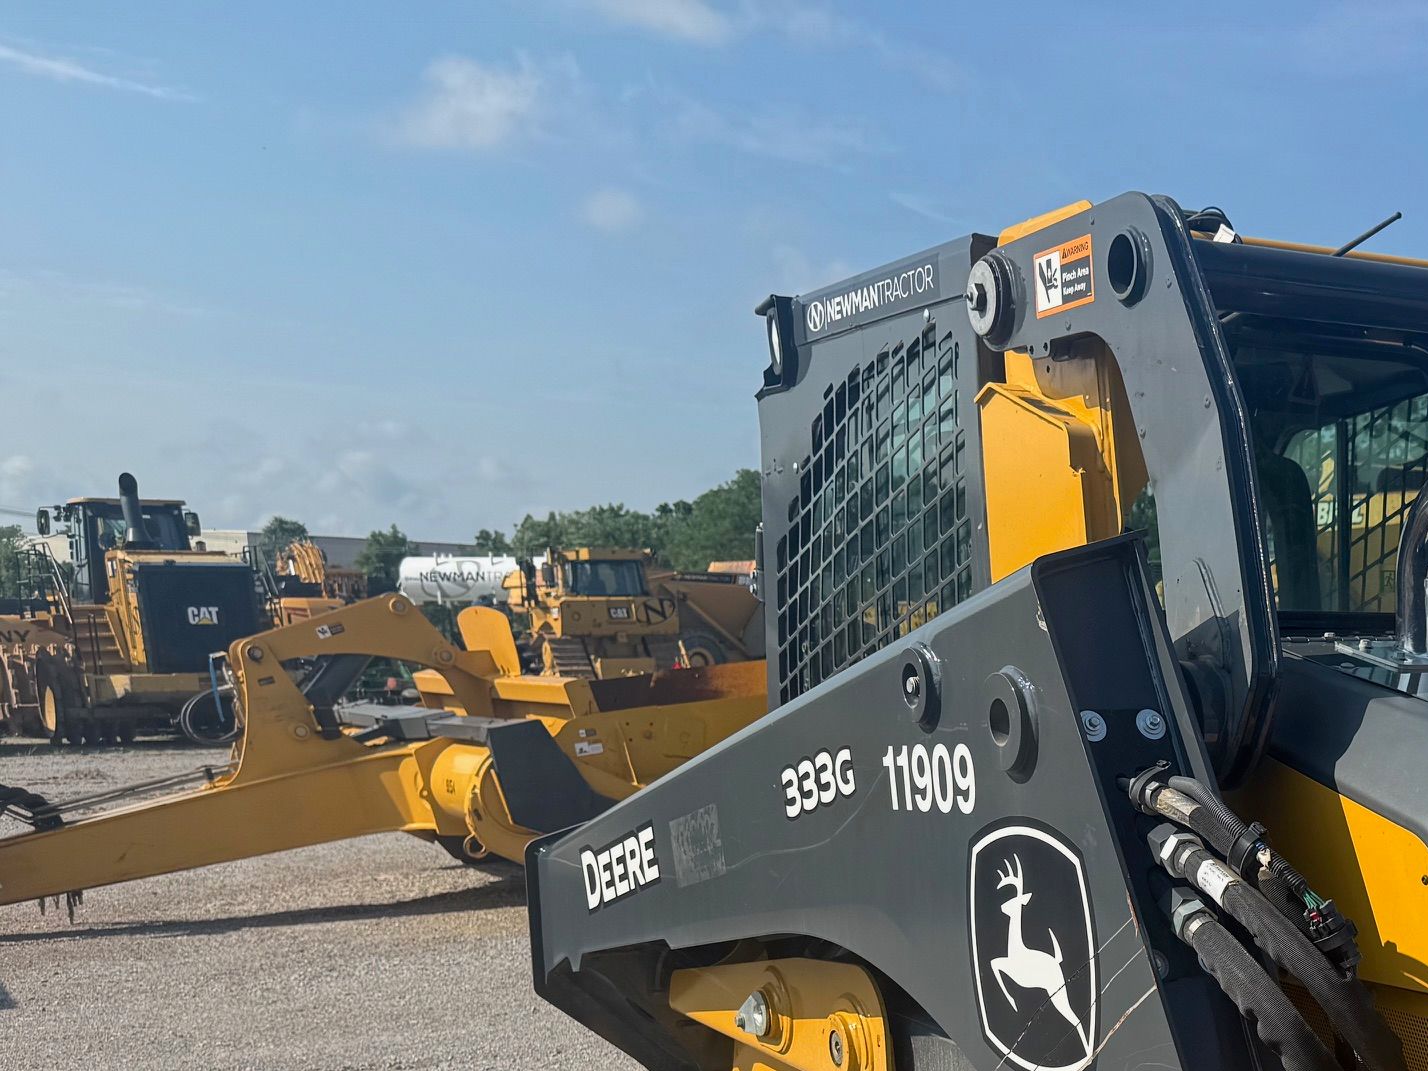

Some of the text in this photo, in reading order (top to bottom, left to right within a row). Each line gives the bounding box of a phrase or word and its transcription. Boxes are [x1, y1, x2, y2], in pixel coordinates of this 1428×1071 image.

[1066, 241, 1089, 257] WARNING
[1062, 267, 1090, 283] Pinch Area
[1063, 282, 1087, 296] Keep Away
[188, 606, 219, 625] CAT
[610, 607, 628, 619] CAT
[781, 743, 976, 818] 333G 11909
[580, 826, 660, 910] DEERE
